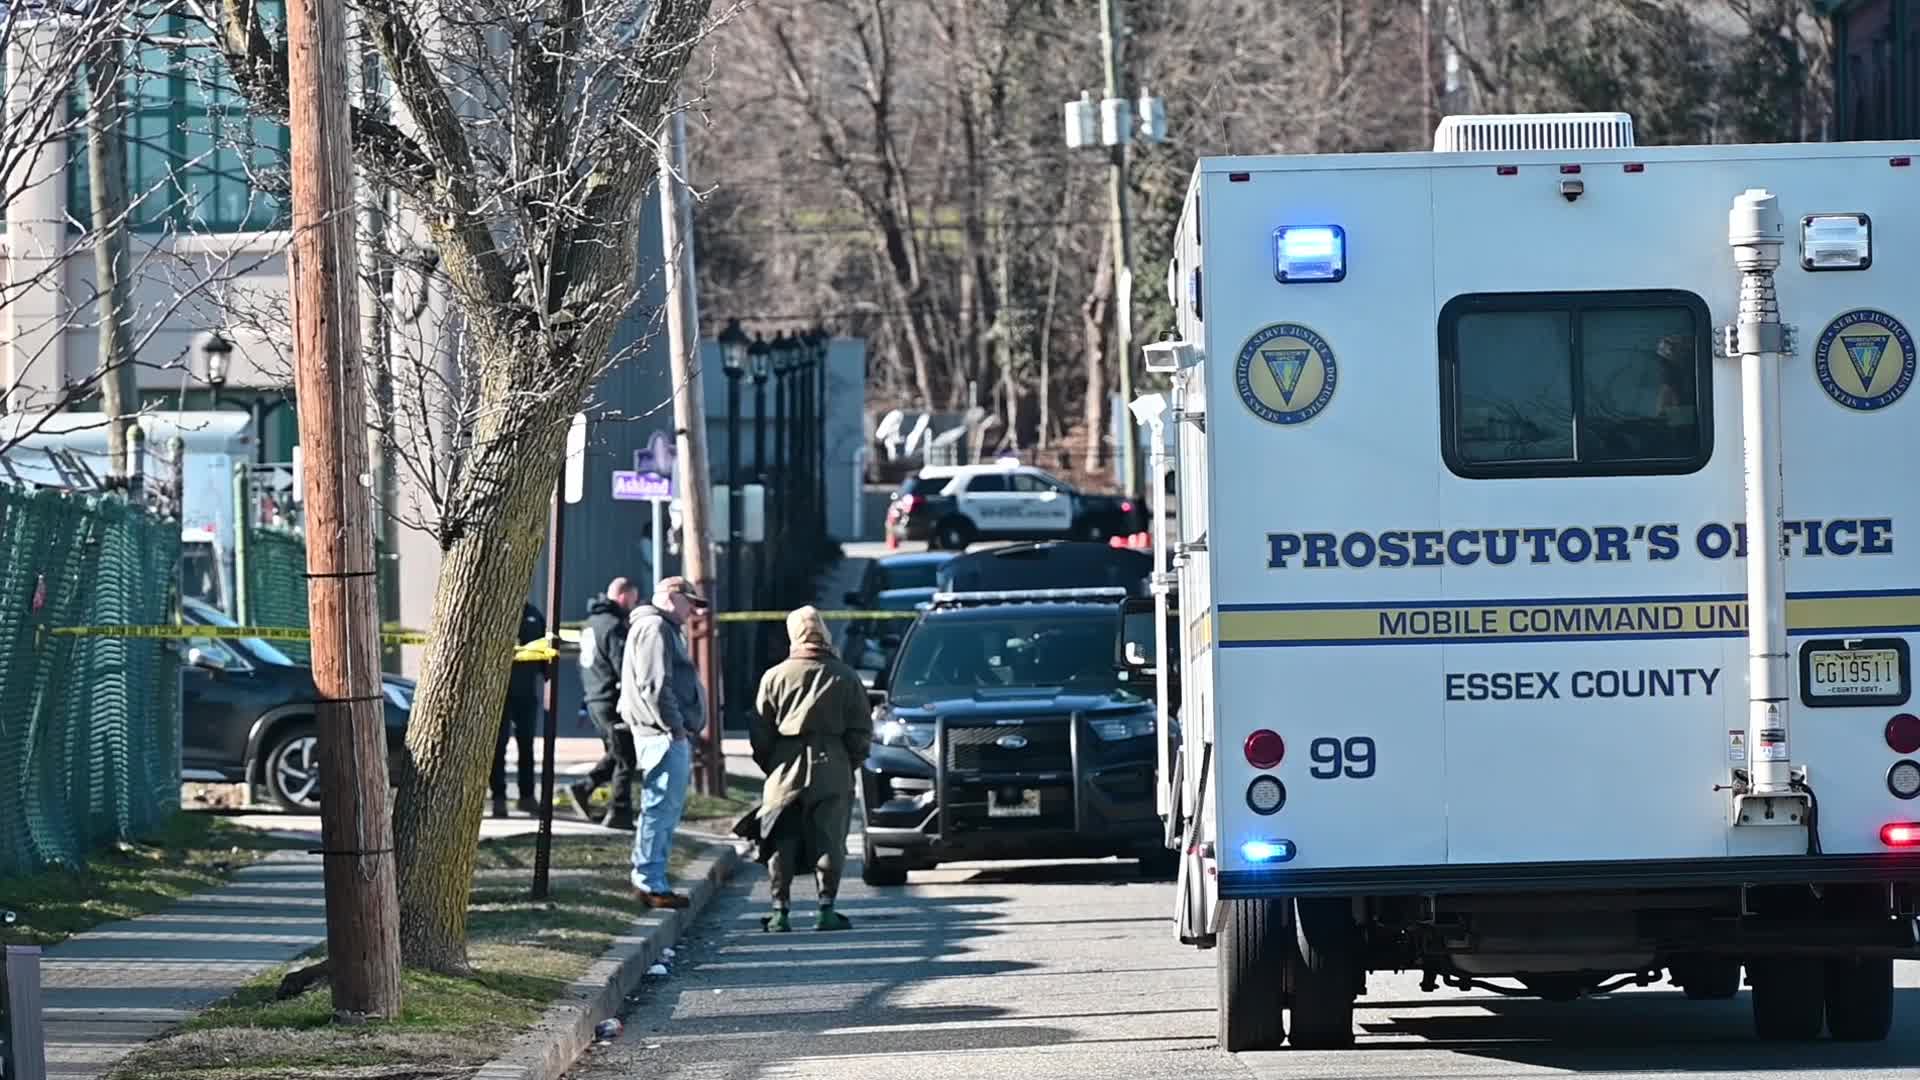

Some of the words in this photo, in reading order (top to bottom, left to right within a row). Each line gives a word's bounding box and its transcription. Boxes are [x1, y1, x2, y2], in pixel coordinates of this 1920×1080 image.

[1252, 327, 1286, 346] SERVE
[1289, 327, 1328, 355] JUSTICE
[1833, 313, 1866, 331] SERVE
[1869, 313, 1908, 341] JUSTICE
[1239, 353, 1251, 398] JUSTICE
[1327, 366, 1334, 382] DO
[1819, 338, 1830, 383] JUSTICE
[1906, 352, 1913, 368] DO
[1299, 383, 1332, 419] JUSTICE
[1878, 370, 1912, 405] JUSTICE
[615, 476, 669, 494] Ashland
[1267, 525, 1680, 568] PROSECUTOR'S
[1379, 610, 1498, 635] MOBILE
[1509, 607, 1683, 632] COMMAND
[1695, 605, 1749, 629] UNI
[1446, 672, 1560, 701] ESSEX
[1571, 668, 1721, 698] COUNTY
[1816, 661, 1892, 683] CG19511
[1310, 736, 1376, 780] 99
